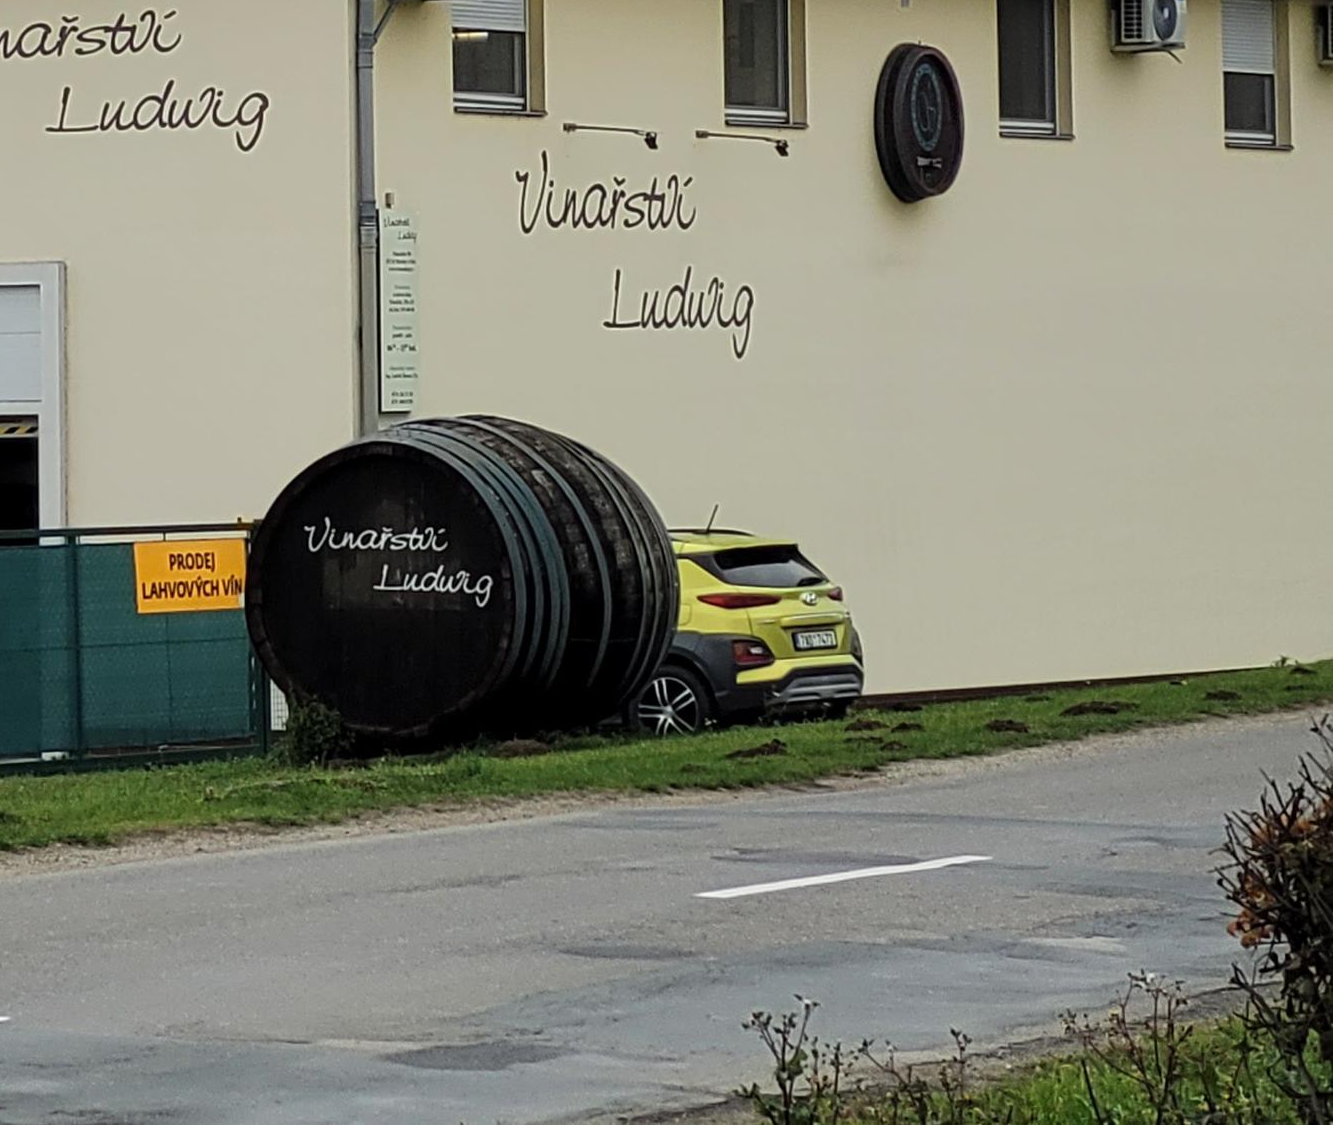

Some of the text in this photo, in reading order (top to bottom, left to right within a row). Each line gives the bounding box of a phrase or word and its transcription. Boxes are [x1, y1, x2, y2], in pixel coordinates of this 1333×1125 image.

[44, 79, 270, 153] Ludwig
[515, 150, 697, 235] Vinařství
[602, 265, 754, 360] Ludwig
[303, 516, 449, 553] Vinařství
[168, 551, 216, 574] PRODEJ
[141, 574, 243, 600] LAHVOVÝCH VÍN
[372, 563, 494, 608] Ludwig
